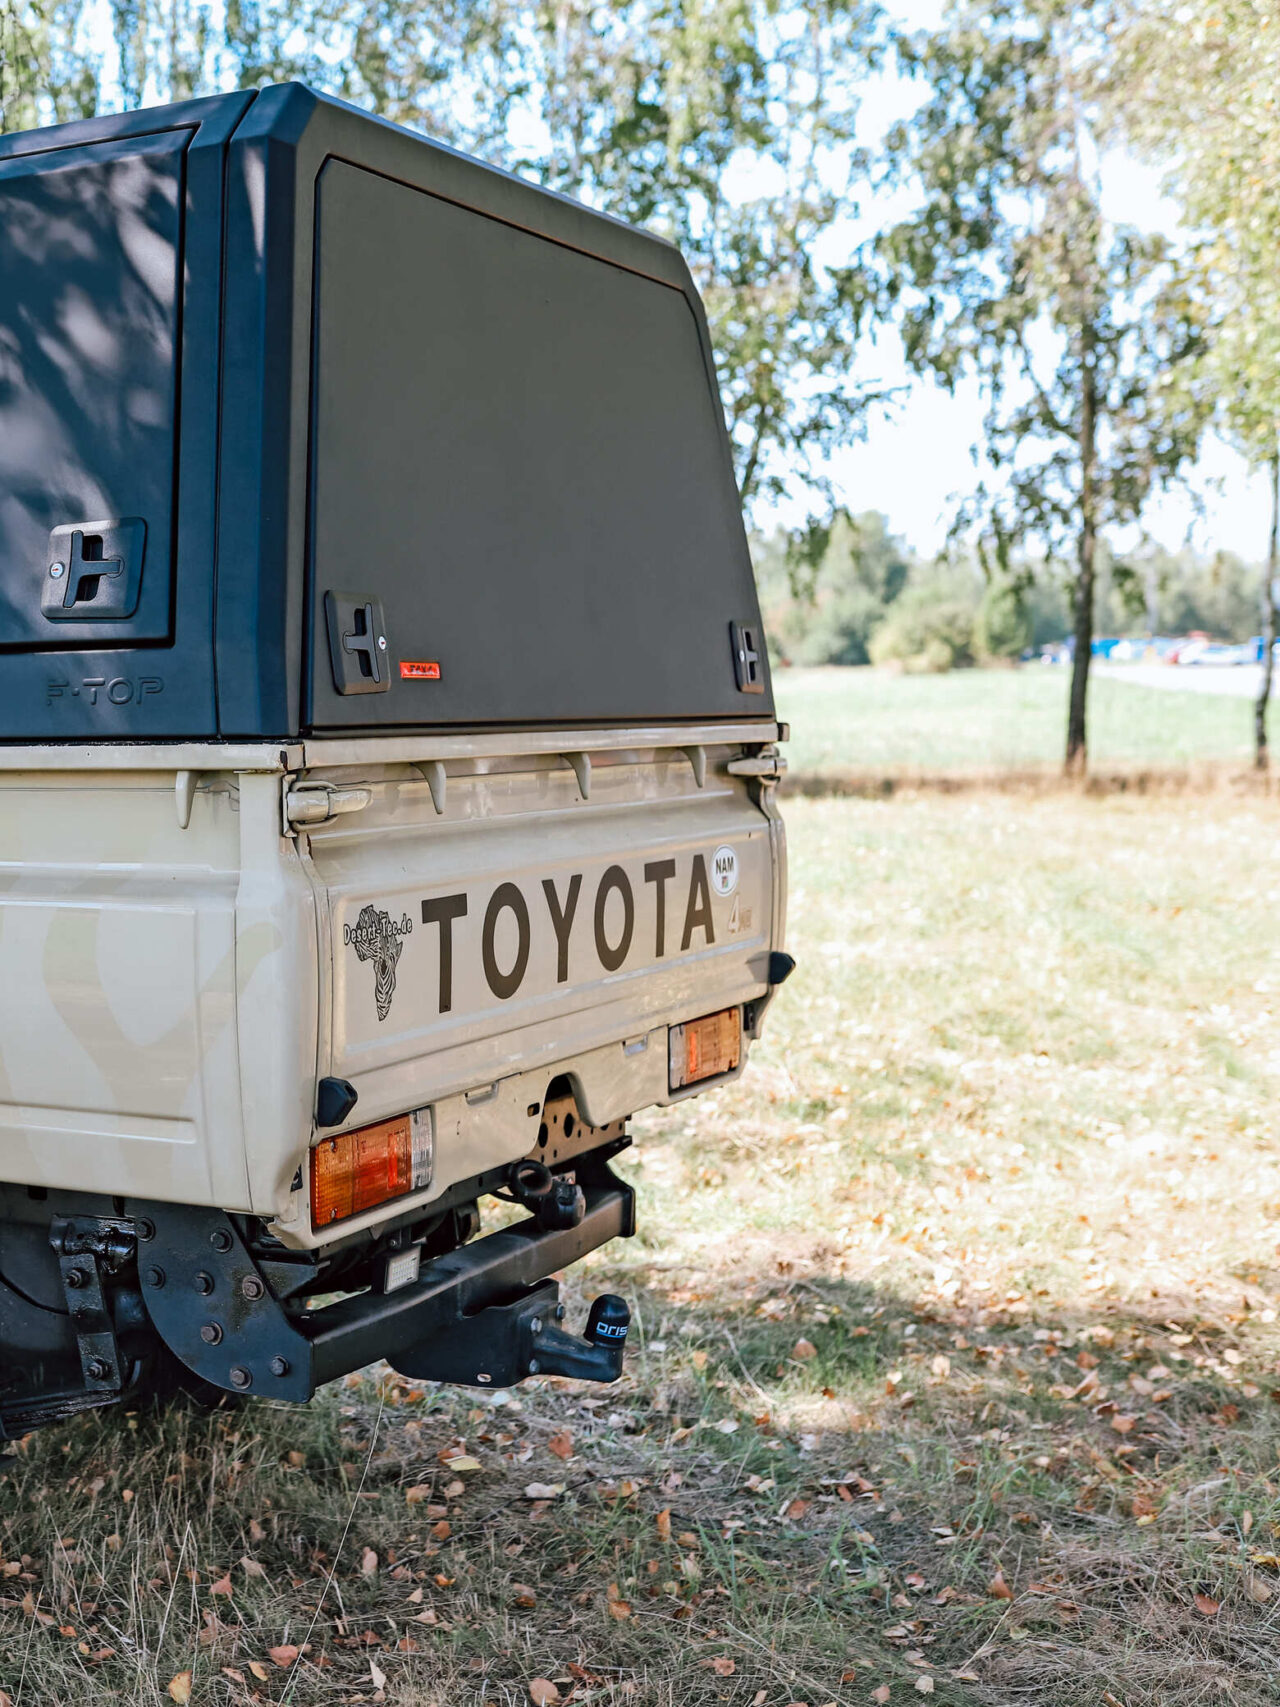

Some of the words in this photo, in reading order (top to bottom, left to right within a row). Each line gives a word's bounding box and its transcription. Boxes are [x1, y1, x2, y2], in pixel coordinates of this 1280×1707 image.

[716, 856, 734, 875] NAM
[343, 912, 413, 946] Desert-Tec.de
[421, 853, 716, 1014] TOYOTA
